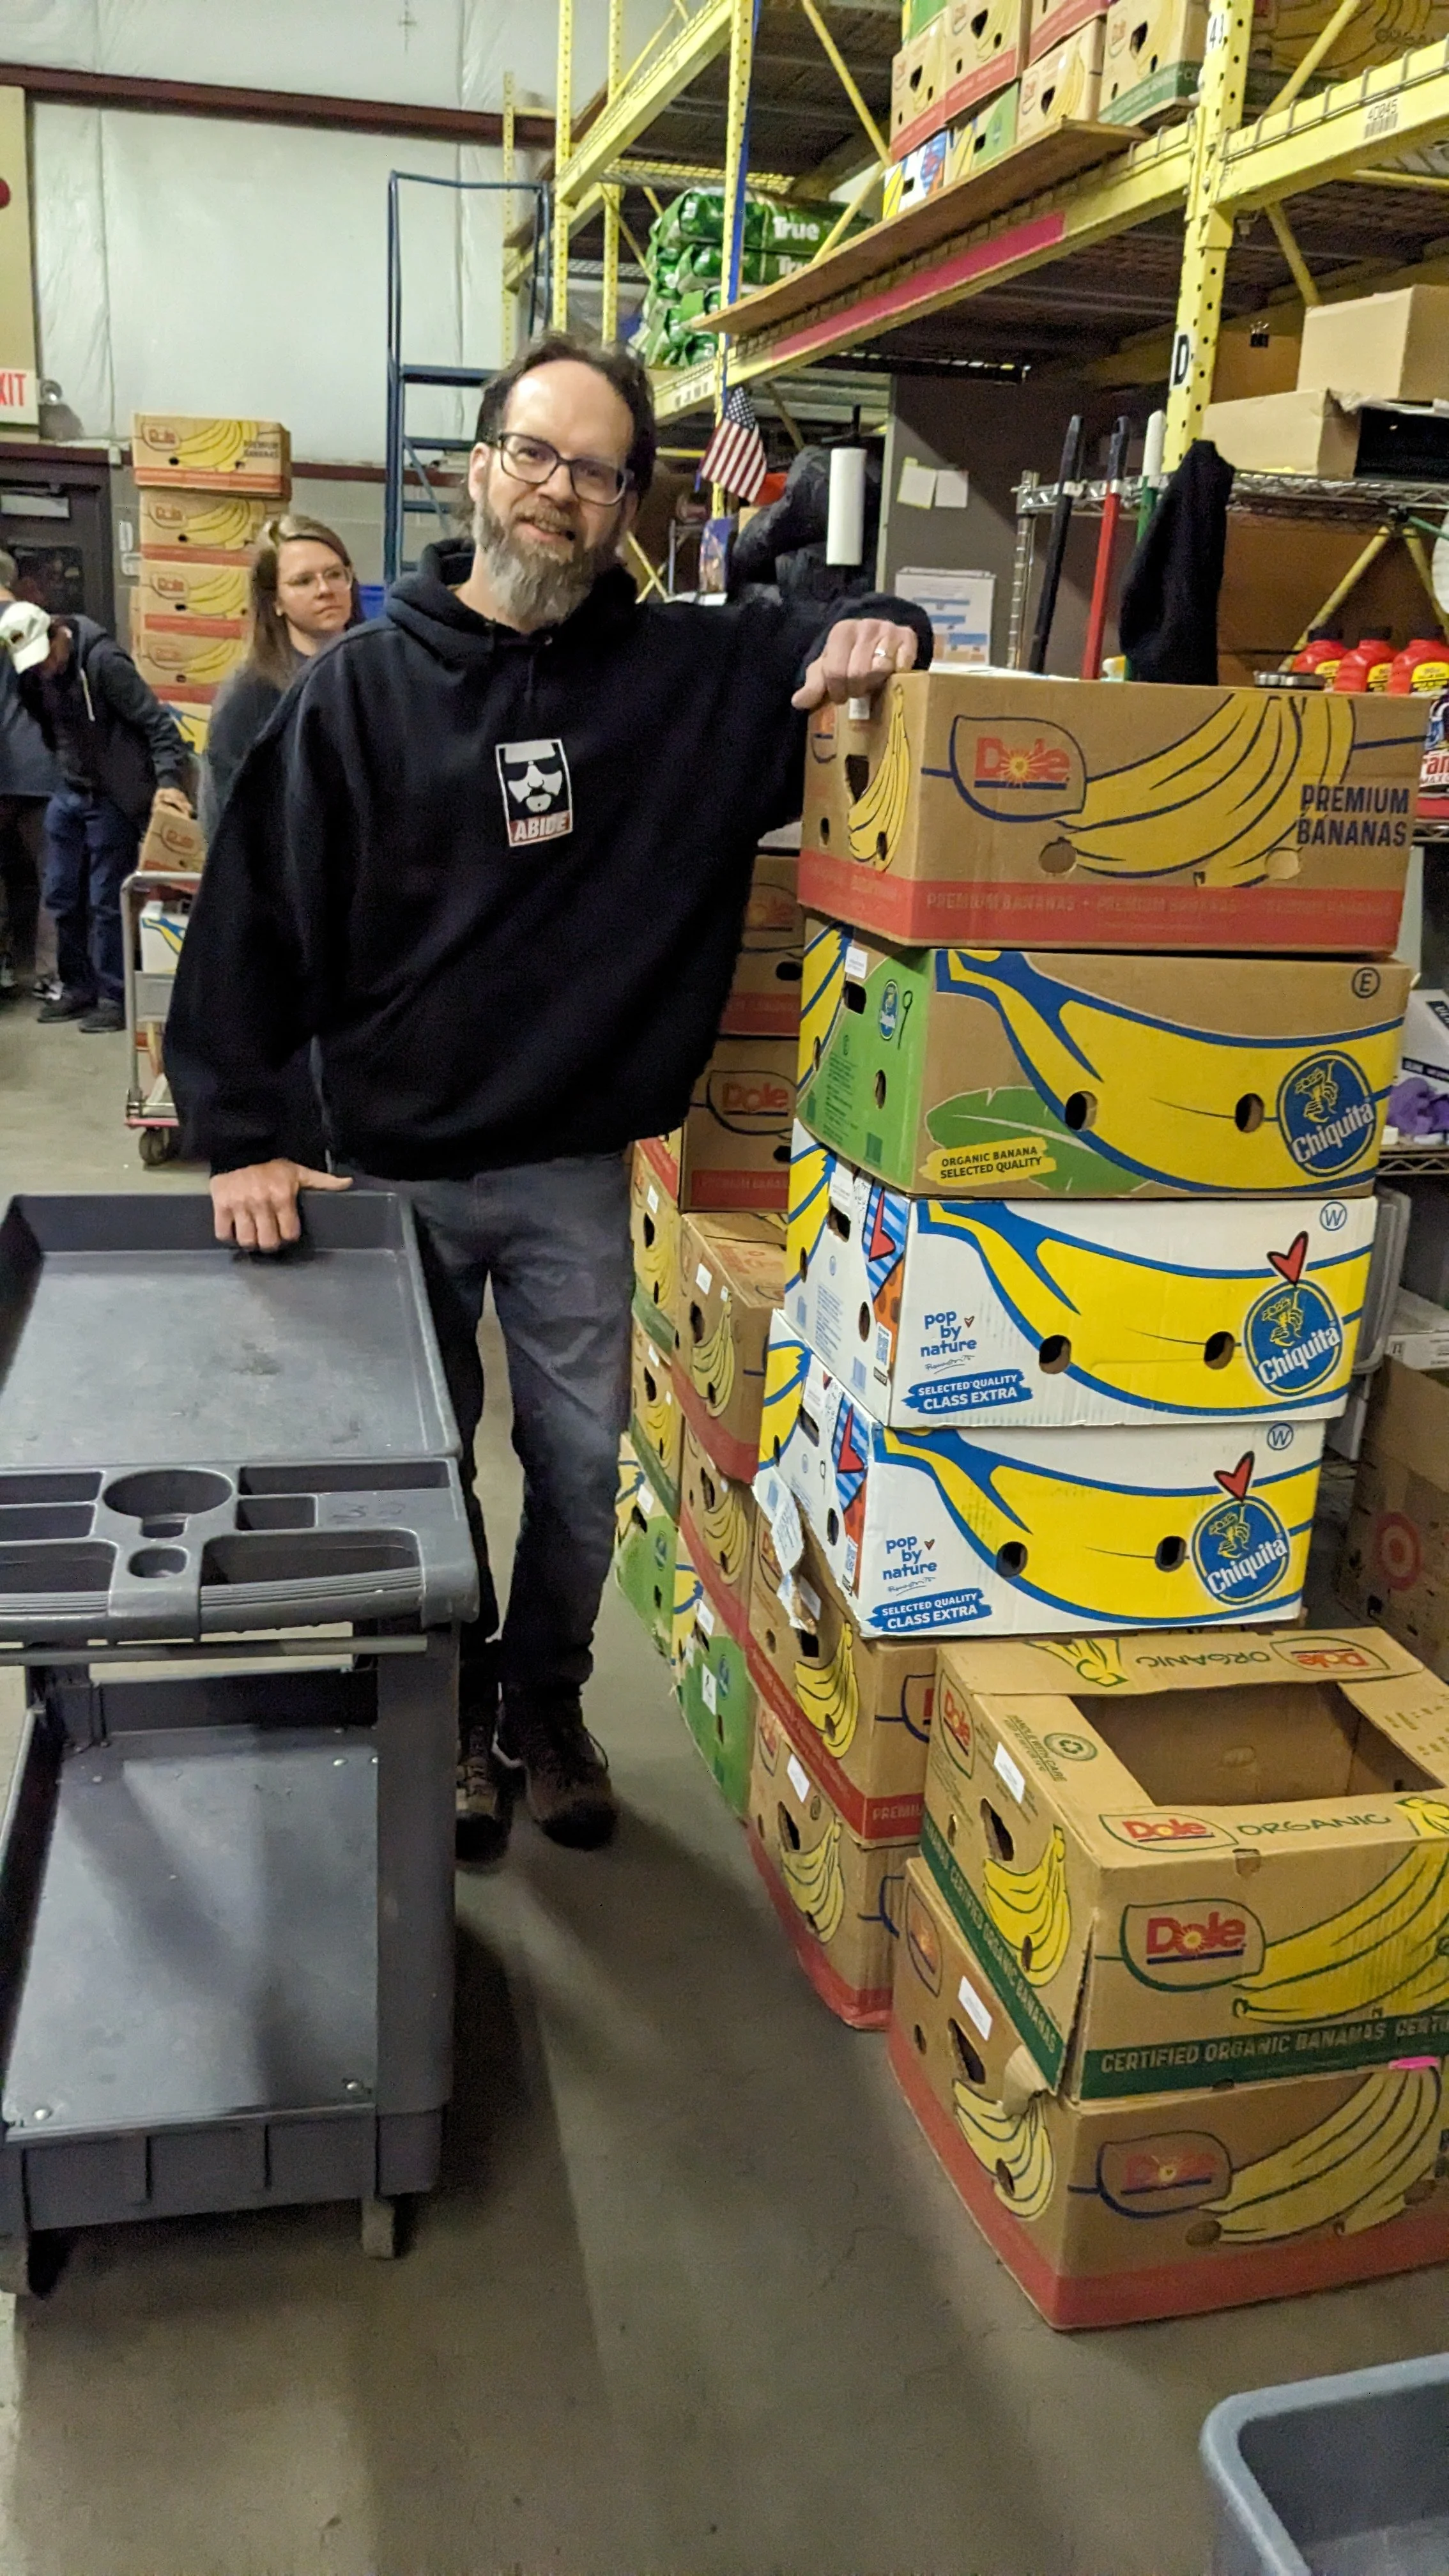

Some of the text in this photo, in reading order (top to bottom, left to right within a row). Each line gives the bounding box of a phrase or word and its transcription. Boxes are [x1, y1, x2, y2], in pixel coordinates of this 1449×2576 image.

[773, 215, 820, 241] True
[776, 256, 811, 275] Tru
[1173, 334, 1189, 386] D
[974, 737, 1071, 782] Dole
[1300, 784, 1410, 815] PREMIUM
[513, 815, 567, 841] ABIDE
[1296, 818, 1407, 847] BANANAS
[1291, 1103, 1374, 1163] Chiquita
[940, 1156, 1041, 1179] SELECTED QUALITY
[941, 1146, 1038, 1167] ORGANIC BANANA
[924, 1310, 957, 1330] pop
[940, 1324, 962, 1341] by
[920, 1338, 977, 1357] nature
[1258, 1326, 1341, 1384] Chiquita
[917, 1374, 1017, 1397] SELECTED QUALITY
[923, 1386, 1018, 1410] CLASS EXTRA
[885, 1535, 917, 1554] pop
[901, 1549, 923, 1564] by
[882, 1561, 937, 1580] nature
[1207, 1538, 1288, 1595] Chiquita
[882, 1593, 977, 1616] SELECTED QUALITY
[887, 1604, 978, 1629] CLASS EXTRA
[1135, 1650, 1271, 1667] ORGANIC
[1296, 1652, 1370, 1668] Dole
[1122, 1813, 1392, 1839] Dole ORGANIC
[1146, 1911, 1246, 1954] Dole
[1101, 2044, 1199, 2073] CERTIFIED
[1204, 2035, 1291, 2062] ORGANIC
[1294, 2022, 1386, 2051] BANANAS
